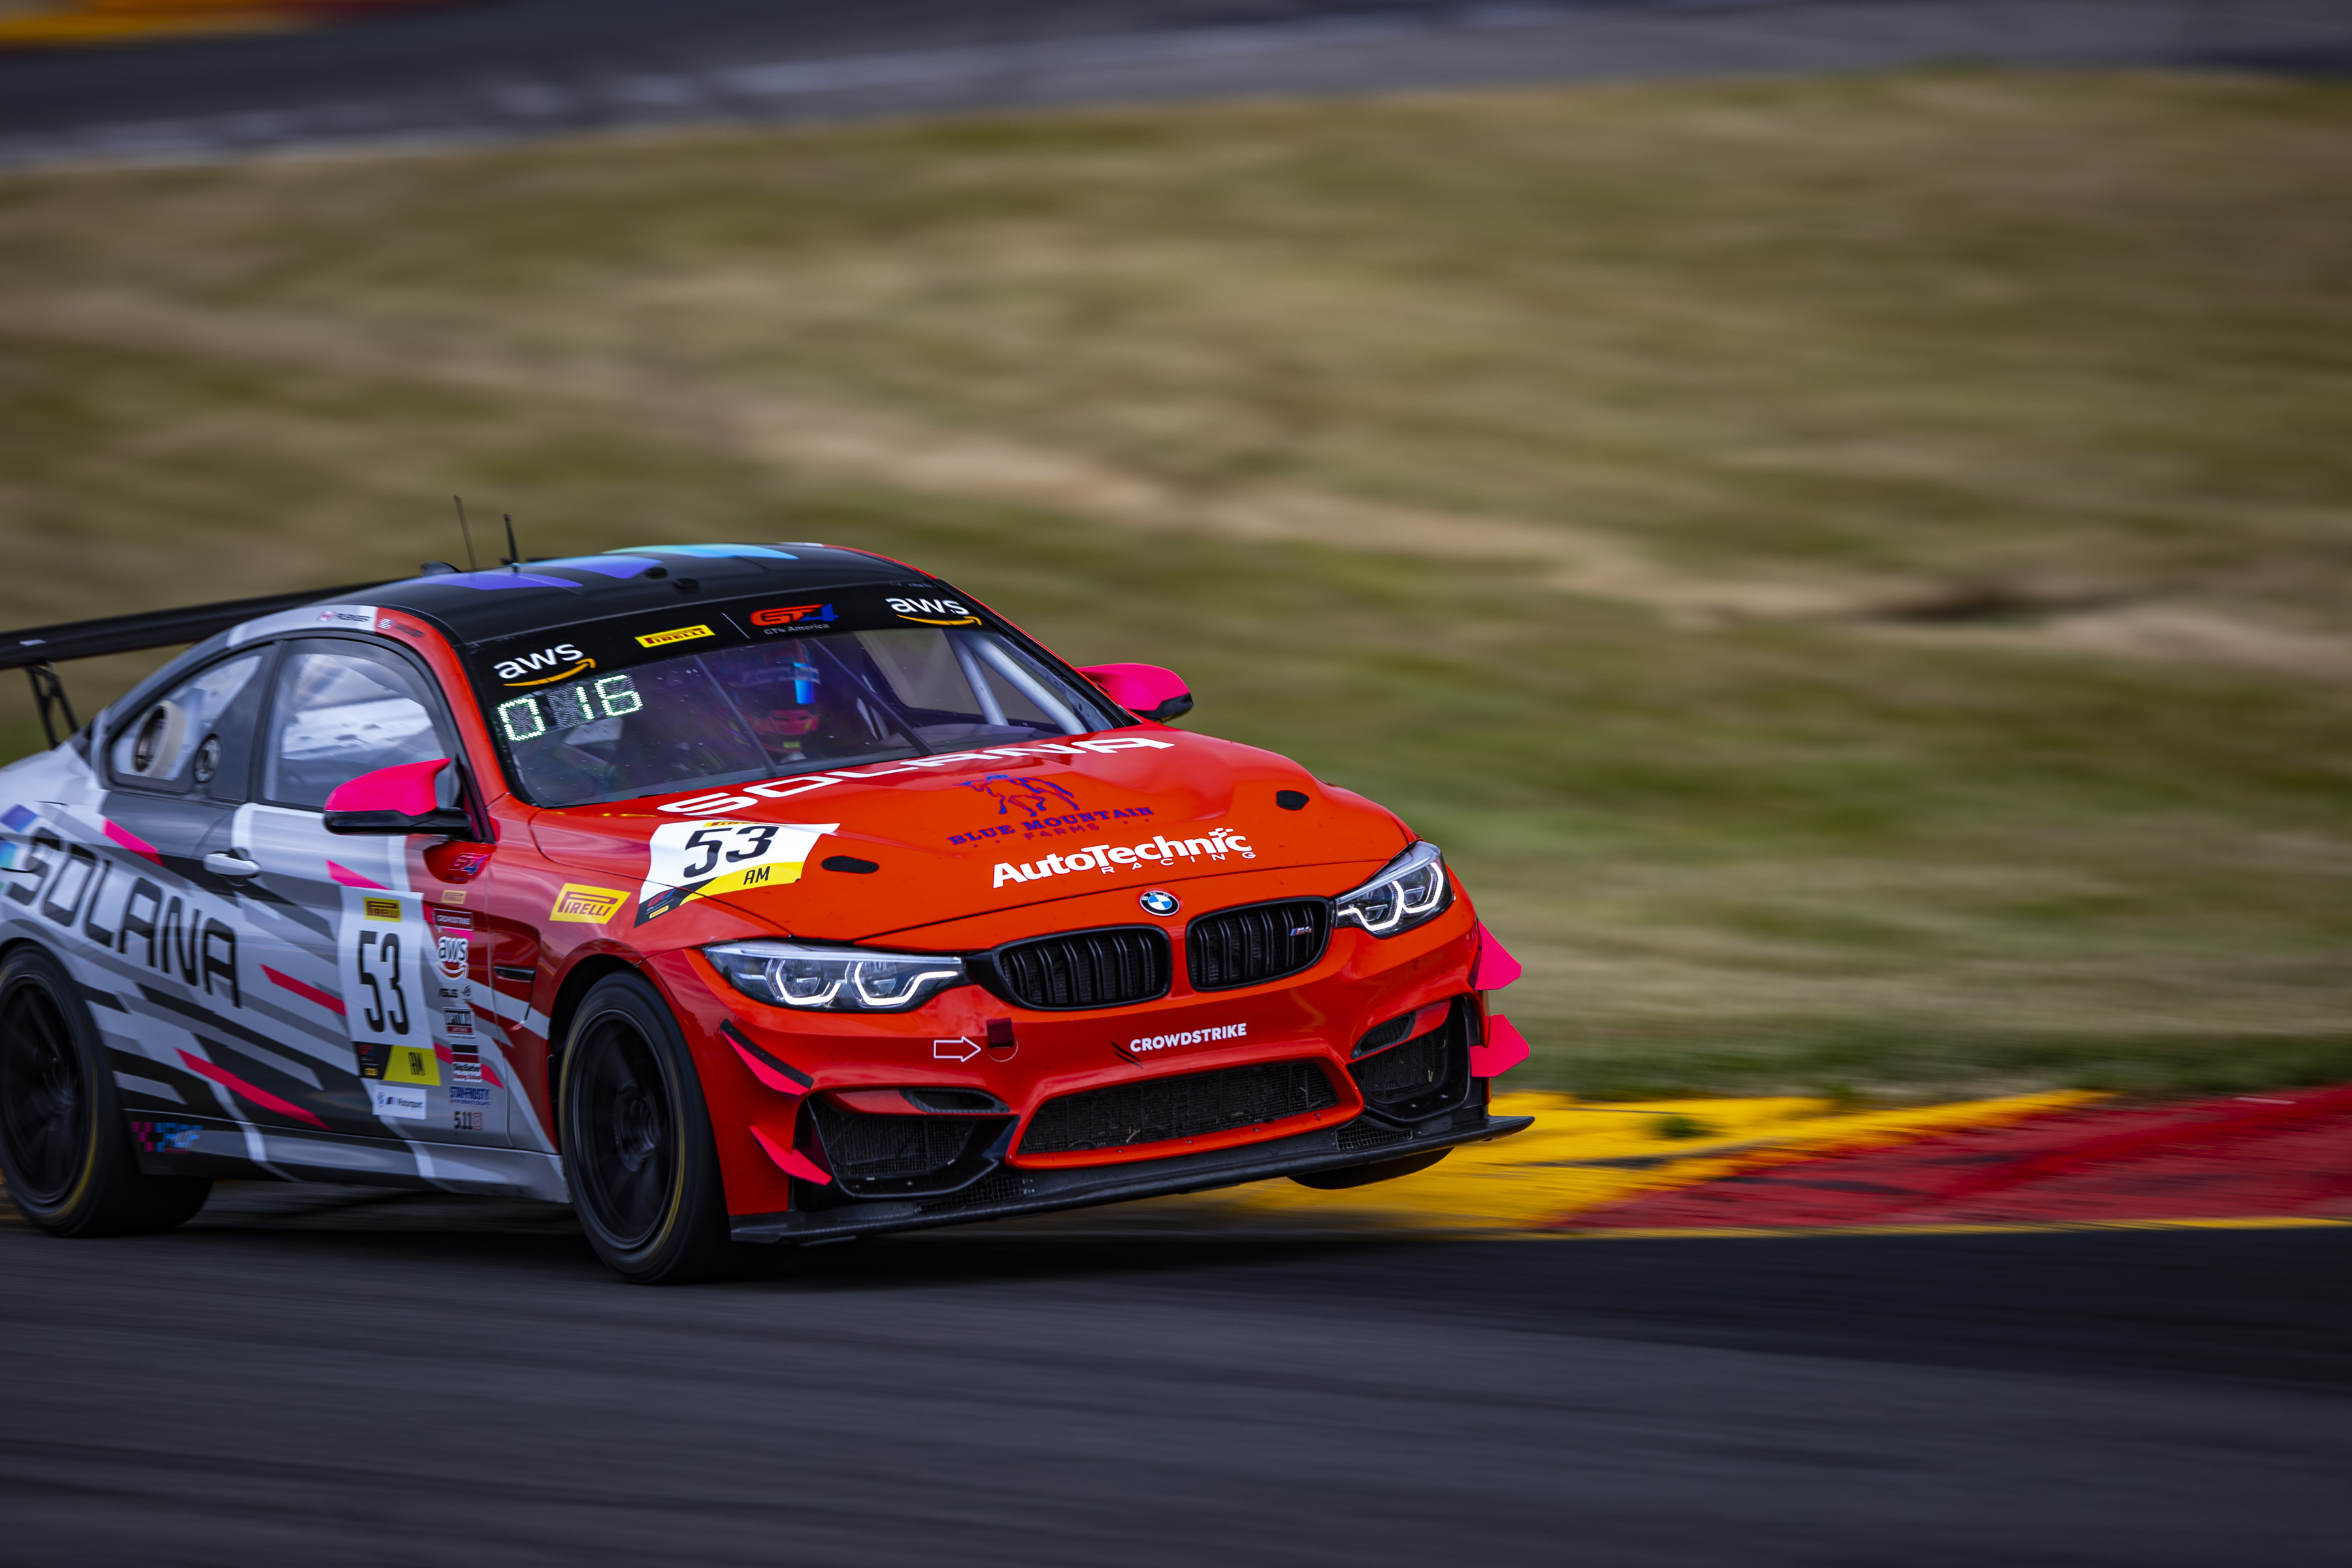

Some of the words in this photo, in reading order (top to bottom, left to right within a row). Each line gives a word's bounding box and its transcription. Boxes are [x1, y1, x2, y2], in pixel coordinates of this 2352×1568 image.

[750, 603, 840, 626] GT4
[885, 598, 970, 615] aws
[787, 623, 830, 632] America
[493, 644, 584, 679] aws
[657, 738, 1175, 816] SOLANA
[947, 825, 1016, 846] BLUE
[1021, 806, 1155, 832] MOUNTAIN
[1023, 823, 1100, 841] FARMS
[683, 826, 780, 878] 53
[992, 827, 1253, 889] AutoTechnic
[1101, 851, 1256, 875] RACING
[743, 866, 771, 885] AM
[366, 900, 399, 919] PIRELLI
[557, 890, 619, 917] PIRELLI
[4, 826, 244, 1009] SOLANA
[438, 938, 466, 961] aws
[357, 930, 411, 1036] 53
[1130, 1022, 1247, 1053] CROWDSTRIKE
